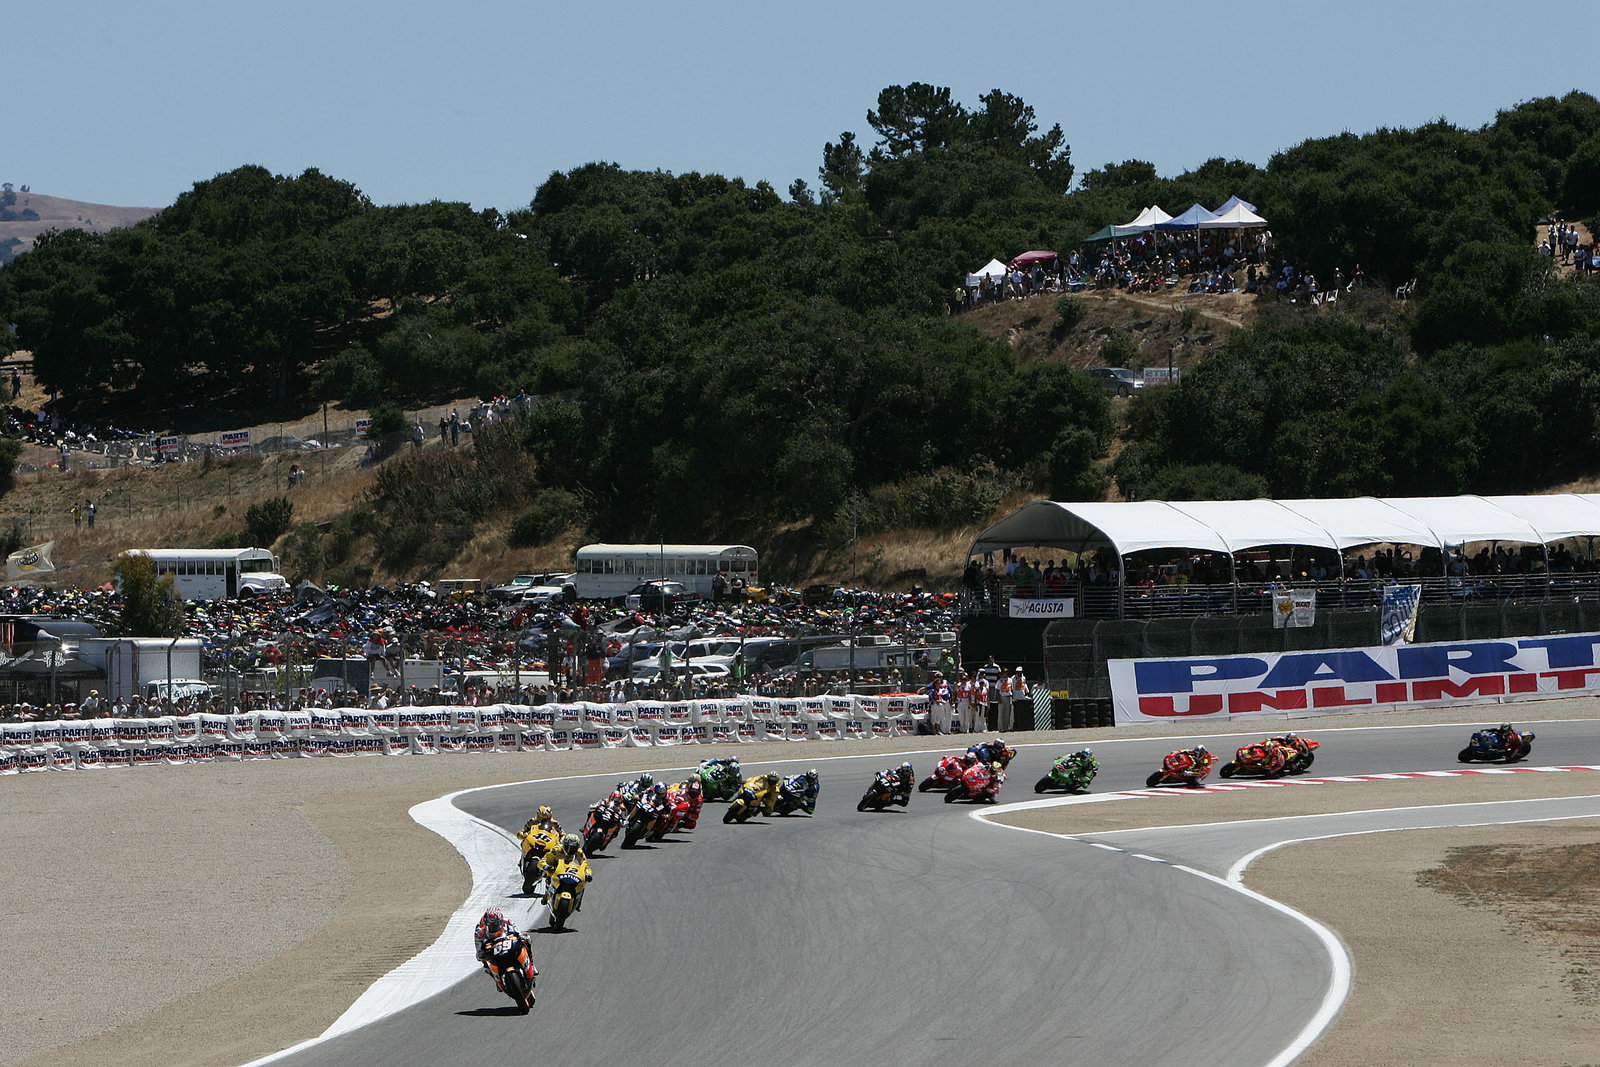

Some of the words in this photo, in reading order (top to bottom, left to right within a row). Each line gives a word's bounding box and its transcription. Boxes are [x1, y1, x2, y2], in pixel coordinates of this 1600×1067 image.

[222, 432, 249, 440] PARTS
[1028, 602, 1064, 613] AGUSTA
[753, 701, 770, 709] PARTS
[832, 700, 850, 708] PARTS
[909, 702, 929, 710] PART
[458, 711, 475, 719] PARTS
[638, 707, 664, 715] PARTS
[341, 715, 368, 723] PARTS
[399, 714, 425, 722] PARTS
[424, 713, 451, 721] PARTS
[481, 714, 504, 722] PARTS
[504, 711, 530, 720] PARTS
[260, 719, 285, 727] PARTS
[290, 717, 309, 725] PARTS
[312, 715, 341, 726] PARTS
[149, 725, 173, 733] PARTS
[202, 720, 228, 730] PARTS
[34, 729, 60, 738] PARTS
[117, 727, 147, 735] PARTS
[572, 731, 598, 739] PARTS
[682, 727, 706, 735] PARTS
[3, 731, 32, 740] PARTS
[467, 735, 493, 743] PARTS
[244, 743, 270, 751] PARTS
[271, 740, 297, 748] PARTS
[355, 739, 384, 747] PARTS
[188, 744, 214, 753] PARTS
[214, 744, 241, 752] PARTS
[103, 749, 130, 757] PARTS
[532, 833, 552, 842] 46
[494, 940, 511, 955] 69
